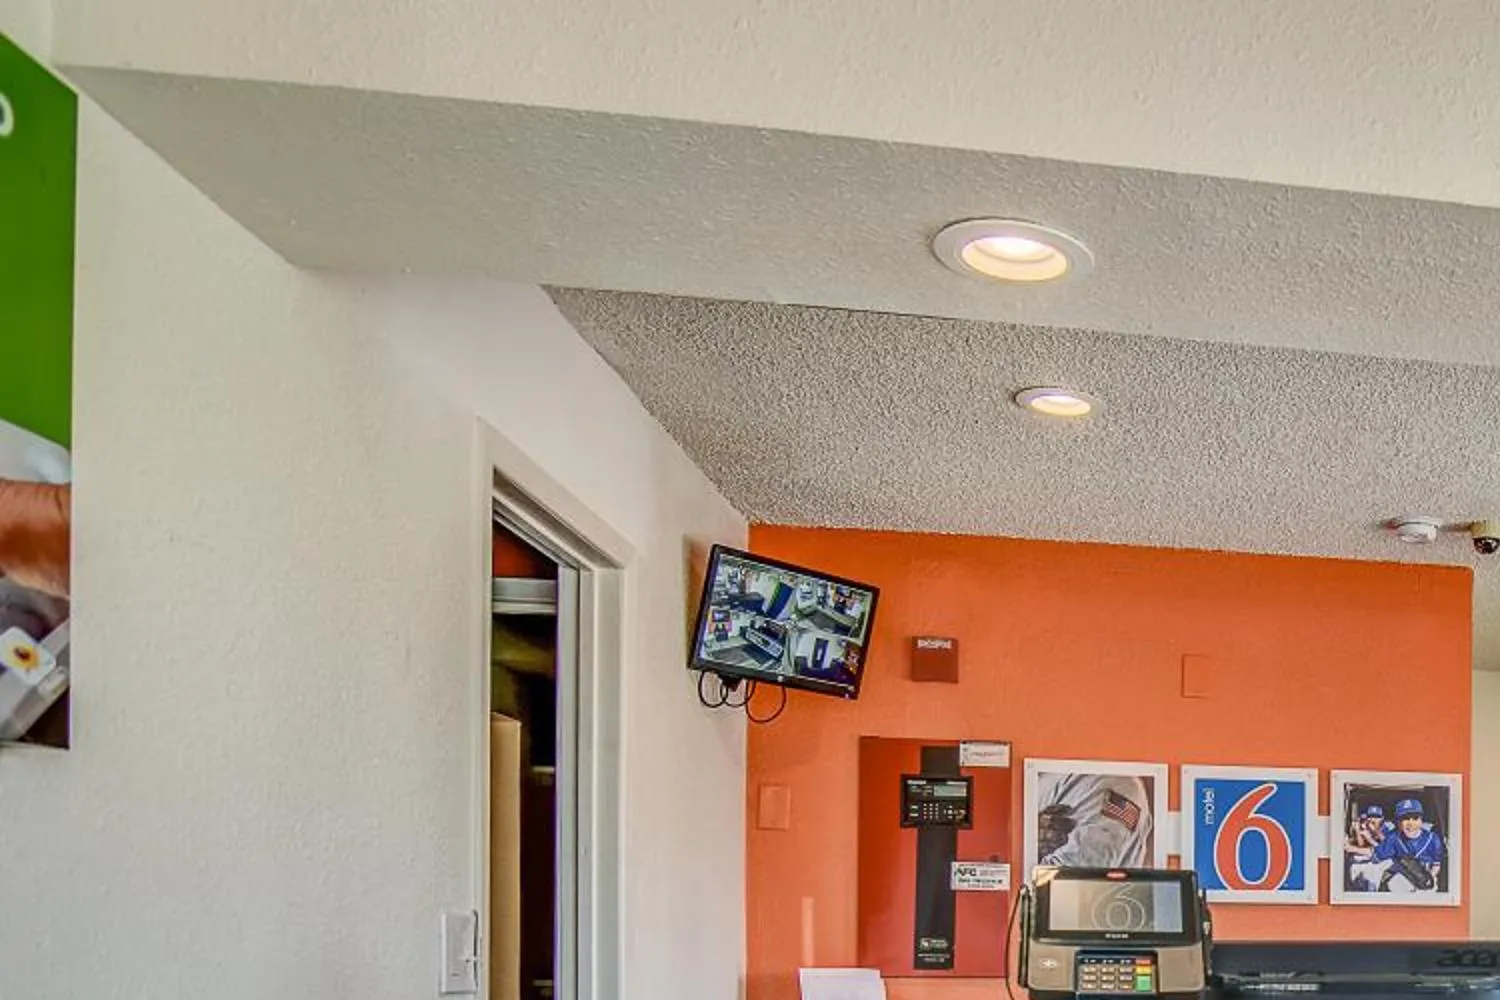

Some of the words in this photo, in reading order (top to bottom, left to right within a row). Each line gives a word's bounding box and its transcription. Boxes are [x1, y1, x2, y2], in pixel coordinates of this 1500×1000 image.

[1202, 787, 1215, 825] motel
[1213, 783, 1292, 891] 6
[1092, 882, 1146, 931] 6
